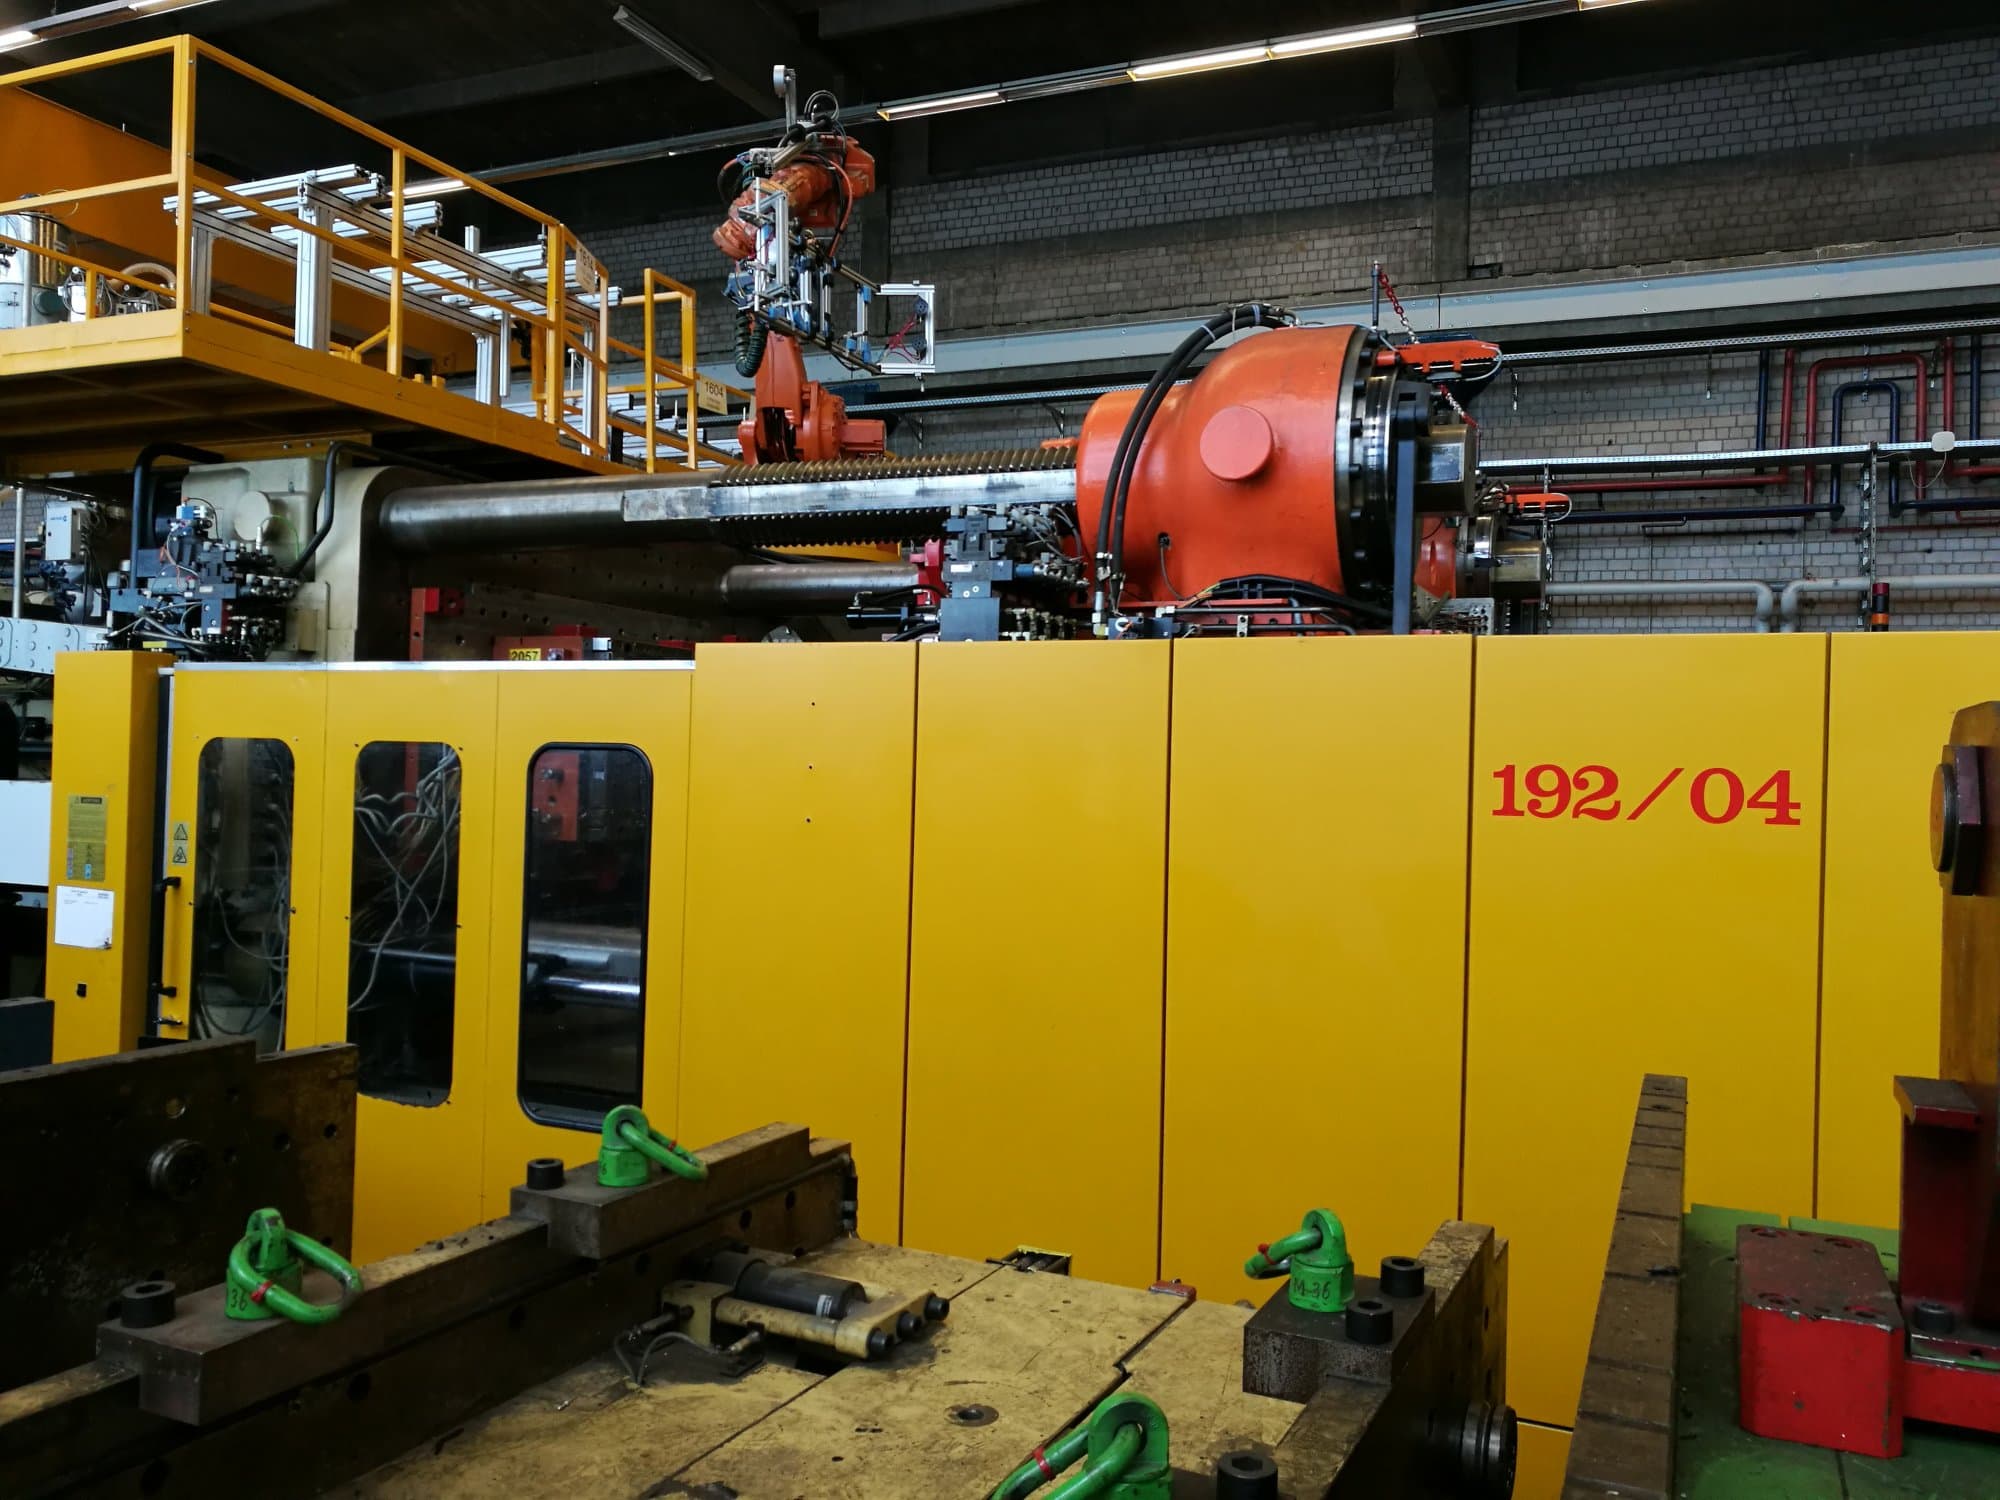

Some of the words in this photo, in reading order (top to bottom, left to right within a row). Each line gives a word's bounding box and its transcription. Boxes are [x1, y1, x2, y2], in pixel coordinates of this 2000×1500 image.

[705, 381, 724, 396] 1604
[511, 650, 539, 661] 2057
[1492, 764, 1801, 825] 192/04
